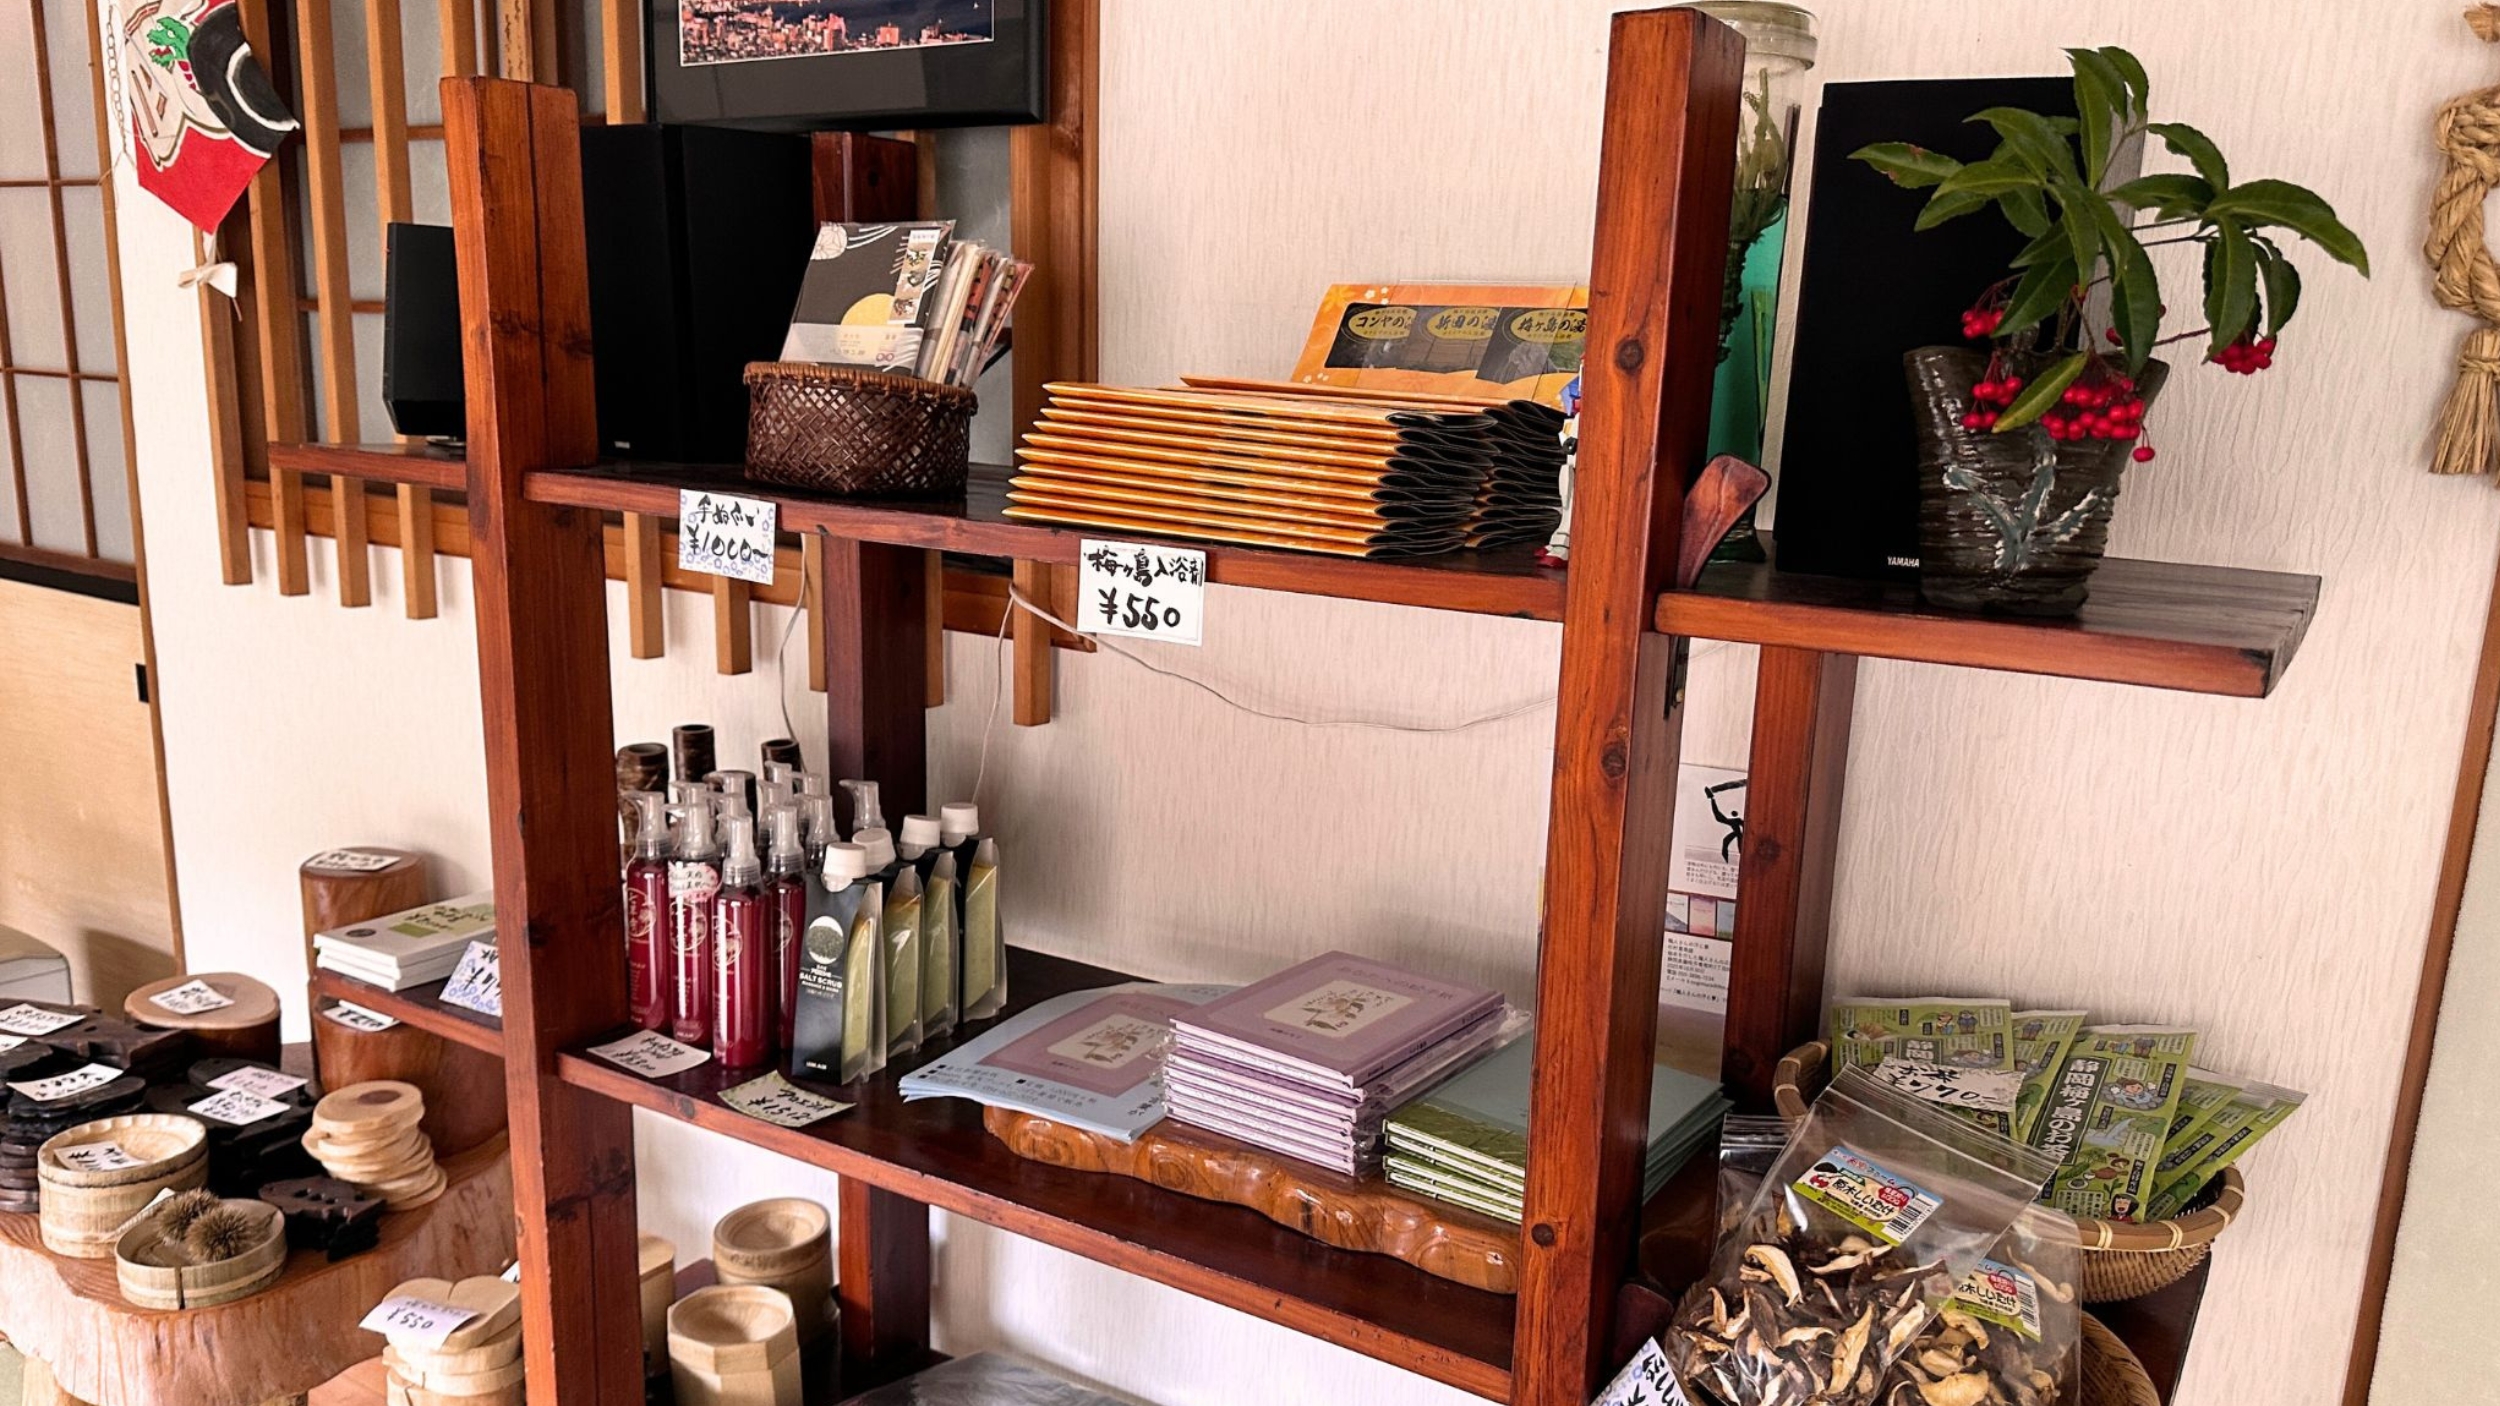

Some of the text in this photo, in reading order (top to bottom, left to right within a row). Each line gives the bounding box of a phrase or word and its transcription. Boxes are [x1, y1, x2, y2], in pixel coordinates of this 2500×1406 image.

[1887, 556, 1920, 568] YAMAHA
[1098, 586, 1181, 630] ¥550
[1832, 1178, 1895, 1216] 原木しいたけ
